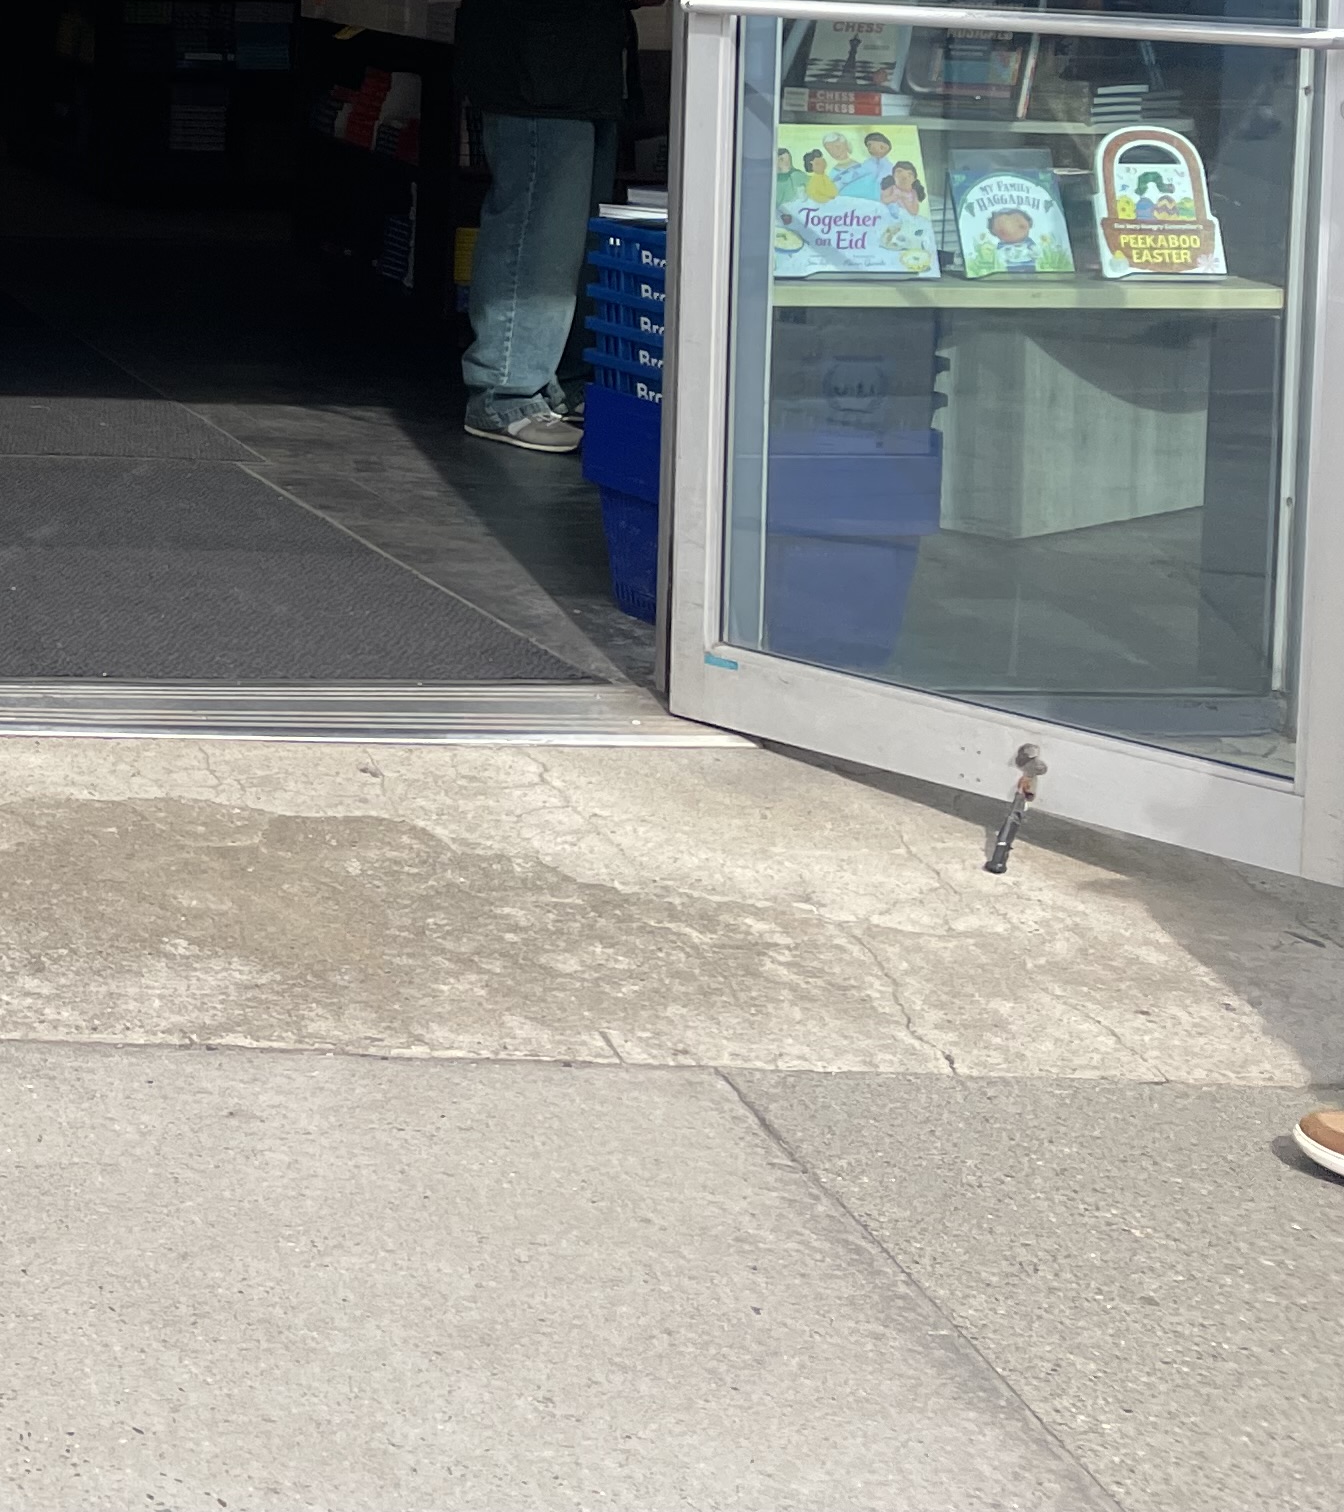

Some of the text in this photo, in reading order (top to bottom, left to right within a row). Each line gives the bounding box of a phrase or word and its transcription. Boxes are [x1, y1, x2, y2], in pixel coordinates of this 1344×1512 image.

[815, 90, 856, 101] CHESS
[815, 103, 855, 114] CHESS
[976, 194, 1040, 211] HAGGADAH
[798, 207, 881, 235] Together
[815, 231, 867, 250] on Eid
[1120, 234, 1200, 248] PEEKABOO
[1132, 250, 1191, 263] EASTER
